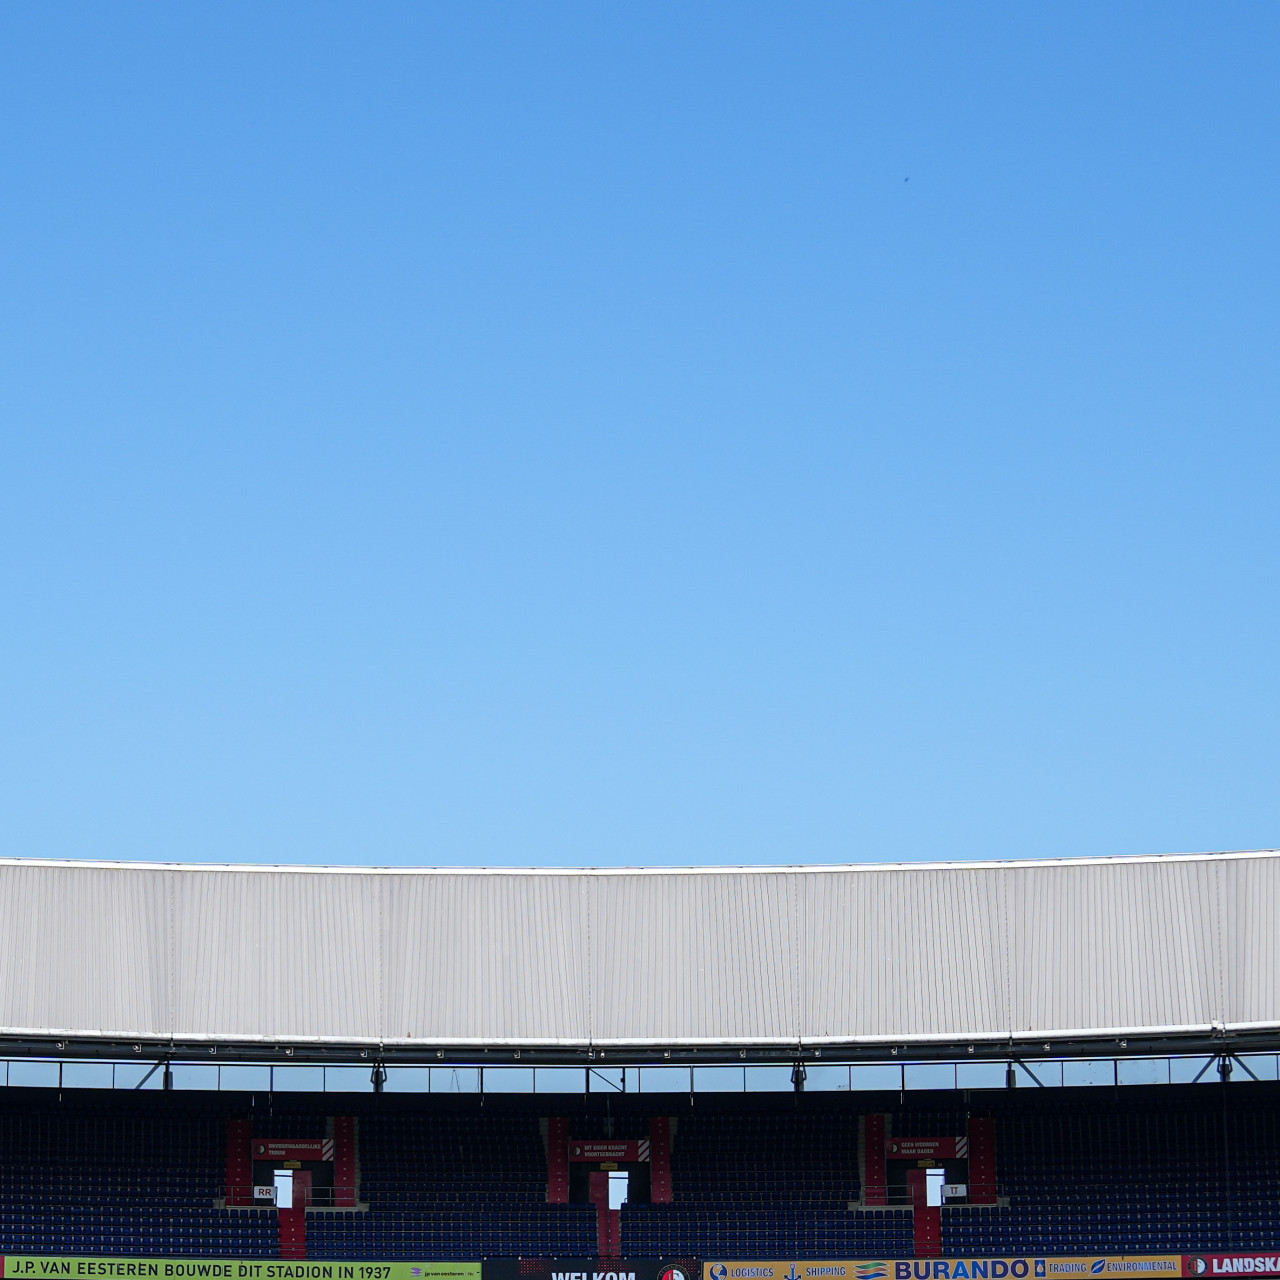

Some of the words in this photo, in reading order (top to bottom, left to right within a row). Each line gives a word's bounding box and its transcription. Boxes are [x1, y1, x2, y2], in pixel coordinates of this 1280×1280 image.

[258, 1188, 272, 1196] RR
[12, 1261, 36, 1275] J.P.
[40, 1261, 70, 1275] VAN
[77, 1262, 158, 1276] EESTEREN
[164, 1263, 232, 1278] BOUWDE
[238, 1264, 262, 1278] DIT
[267, 1265, 333, 1279] STADION
[338, 1266, 354, 1279] IN
[359, 1266, 391, 1280] 1937
[731, 1266, 774, 1278] LOGISTICS
[805, 1266, 846, 1277] SHIPPING
[895, 1258, 1029, 1280] BURANDO
[1049, 1262, 1087, 1274] TRADING
[1106, 1260, 1178, 1273] ENVIRONMENTAL
